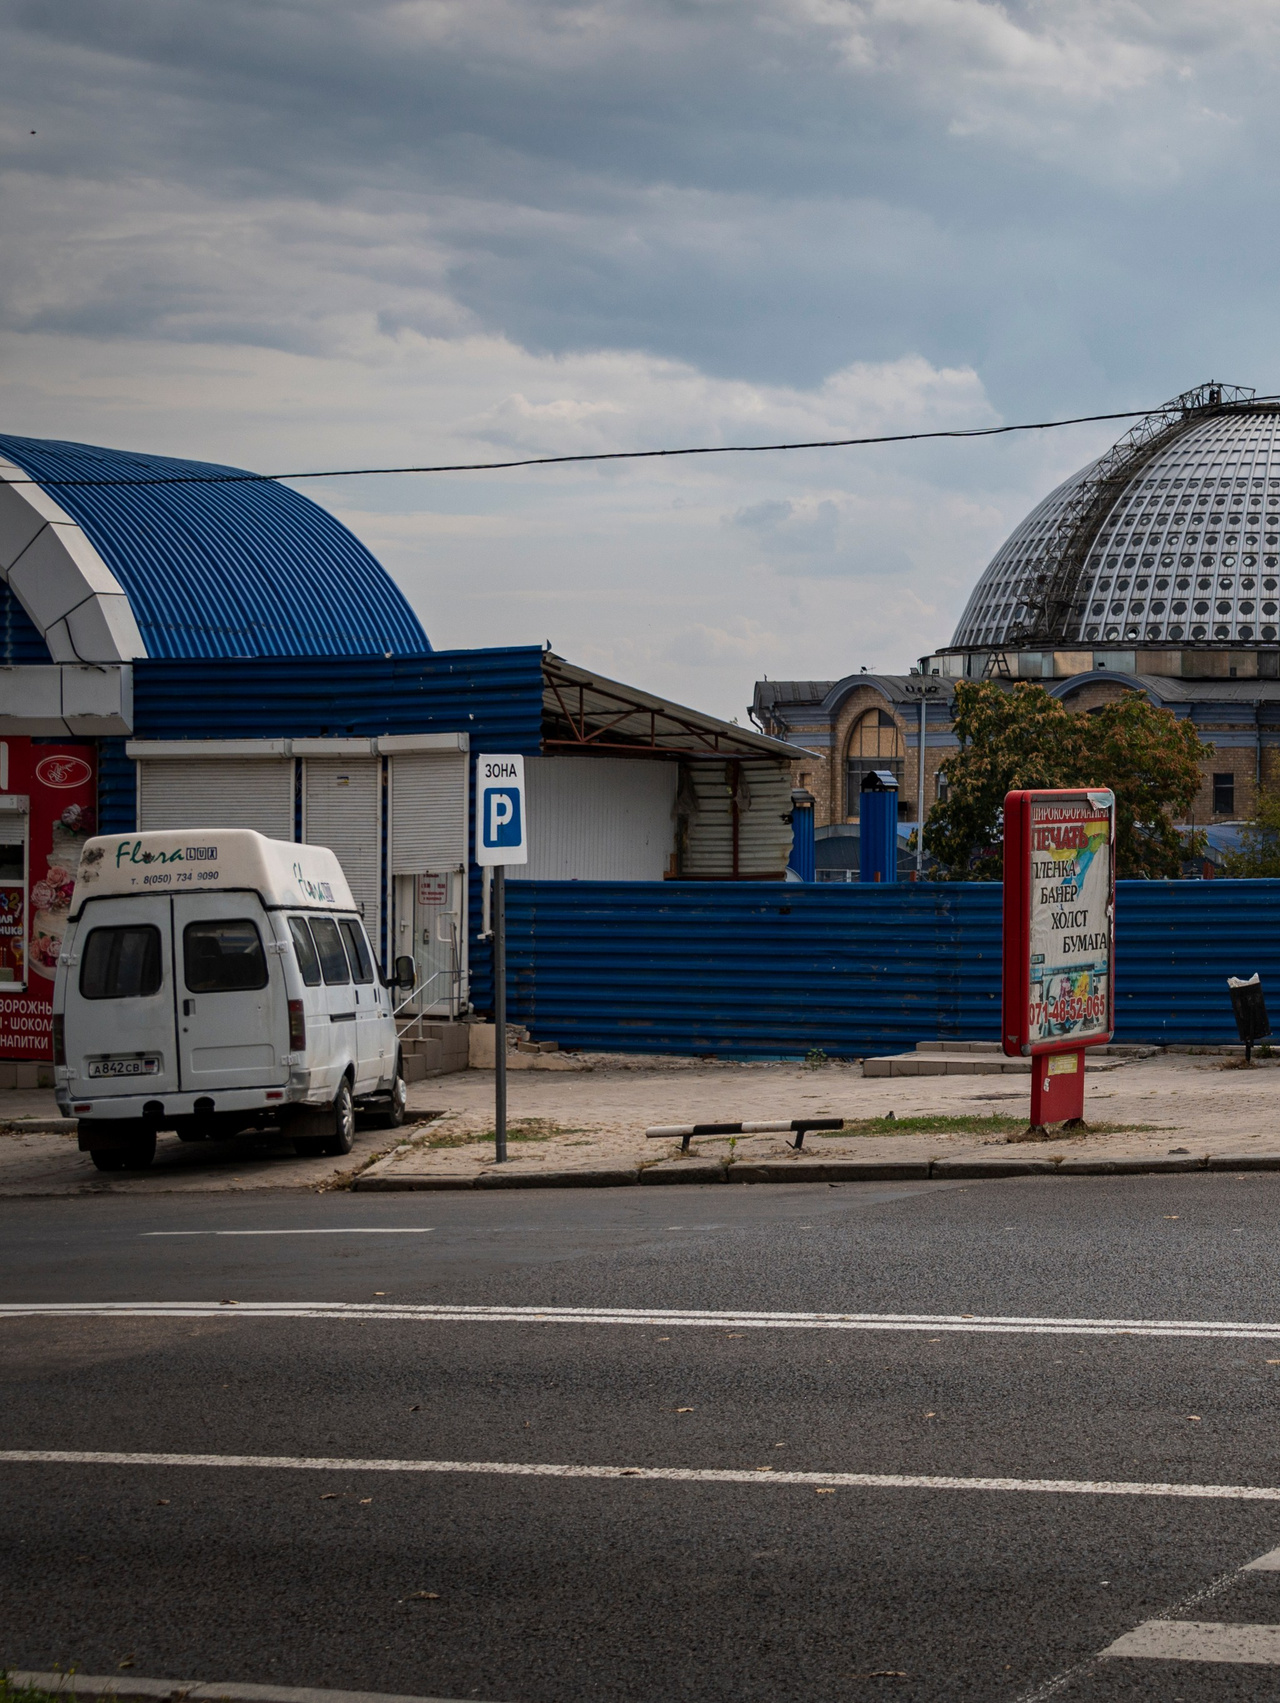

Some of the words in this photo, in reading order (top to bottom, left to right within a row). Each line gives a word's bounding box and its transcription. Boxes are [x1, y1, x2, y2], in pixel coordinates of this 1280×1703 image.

[485, 763, 517, 778] ЗОНА
[490, 793, 513, 841] P
[1032, 825, 1088, 851] ПЕЧАТЬ
[186, 847, 217, 861] LUX
[143, 874, 172, 886] 8(050)
[176, 873, 192, 882] 734
[197, 871, 219, 880] 9090
[1040, 884, 1078, 904] БАНЕР
[1051, 910, 1088, 930] ХОЛСТ
[1062, 932, 1107, 953] БУМАГА
[1029, 993, 1105, 1026] 071-48-52-065
[0, 1034, 49, 1050] НАПИТКИ
